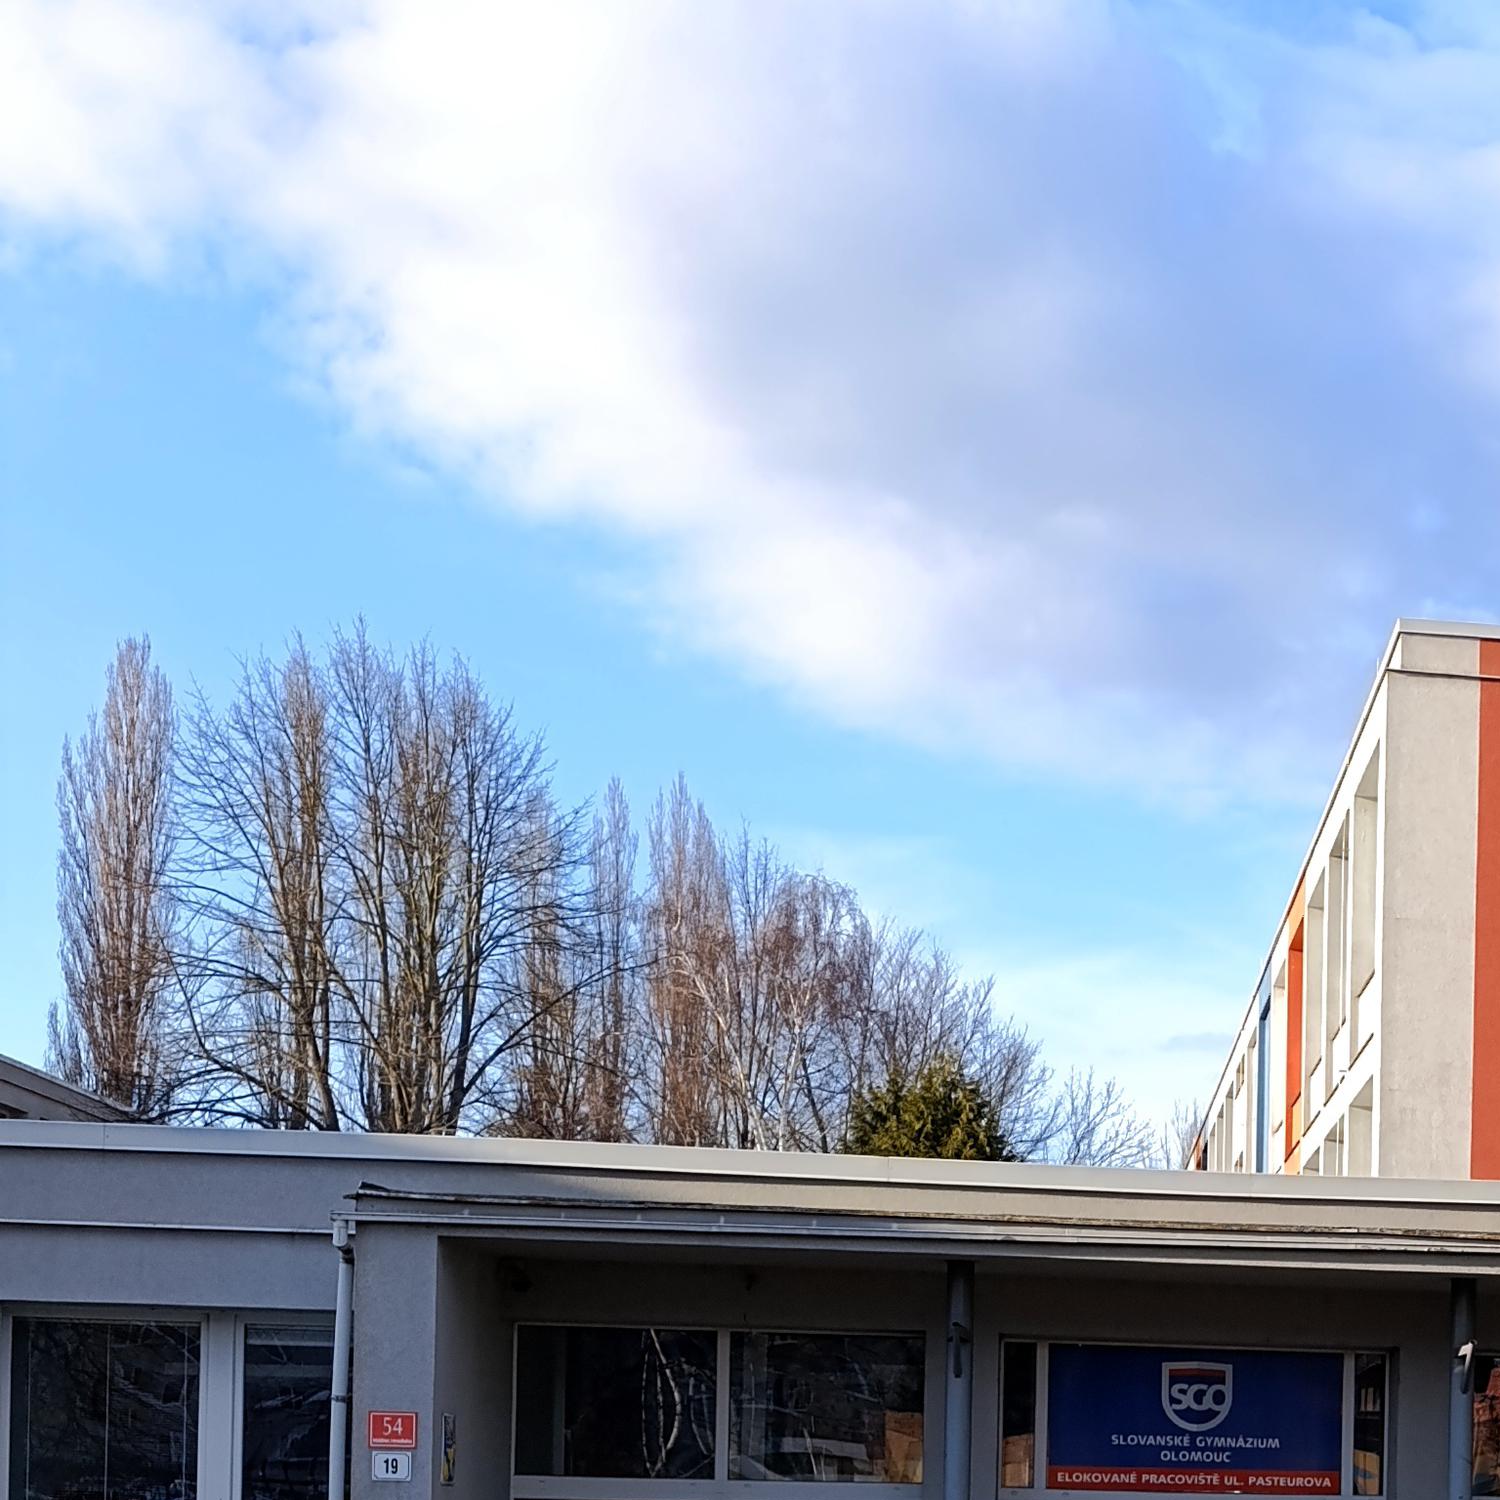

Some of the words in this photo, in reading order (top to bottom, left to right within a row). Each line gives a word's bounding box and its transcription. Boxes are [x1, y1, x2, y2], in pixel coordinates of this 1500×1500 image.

[1170, 1383, 1226, 1412] SGO
[383, 1417, 403, 1435] 54
[1111, 1433, 1190, 1447] SLOVANSKÉ
[1196, 1434, 1280, 1449] GYMNÁZIUM
[1160, 1450, 1231, 1463] OLOMOUC
[384, 1458, 398, 1474] 19
[1057, 1471, 1137, 1484] ELOKOVANÉ
[1141, 1472, 1219, 1485] PRACOVIŠTĚ
[1224, 1476, 1244, 1487] UL.
[1248, 1477, 1332, 1488] PASTEUROVA
